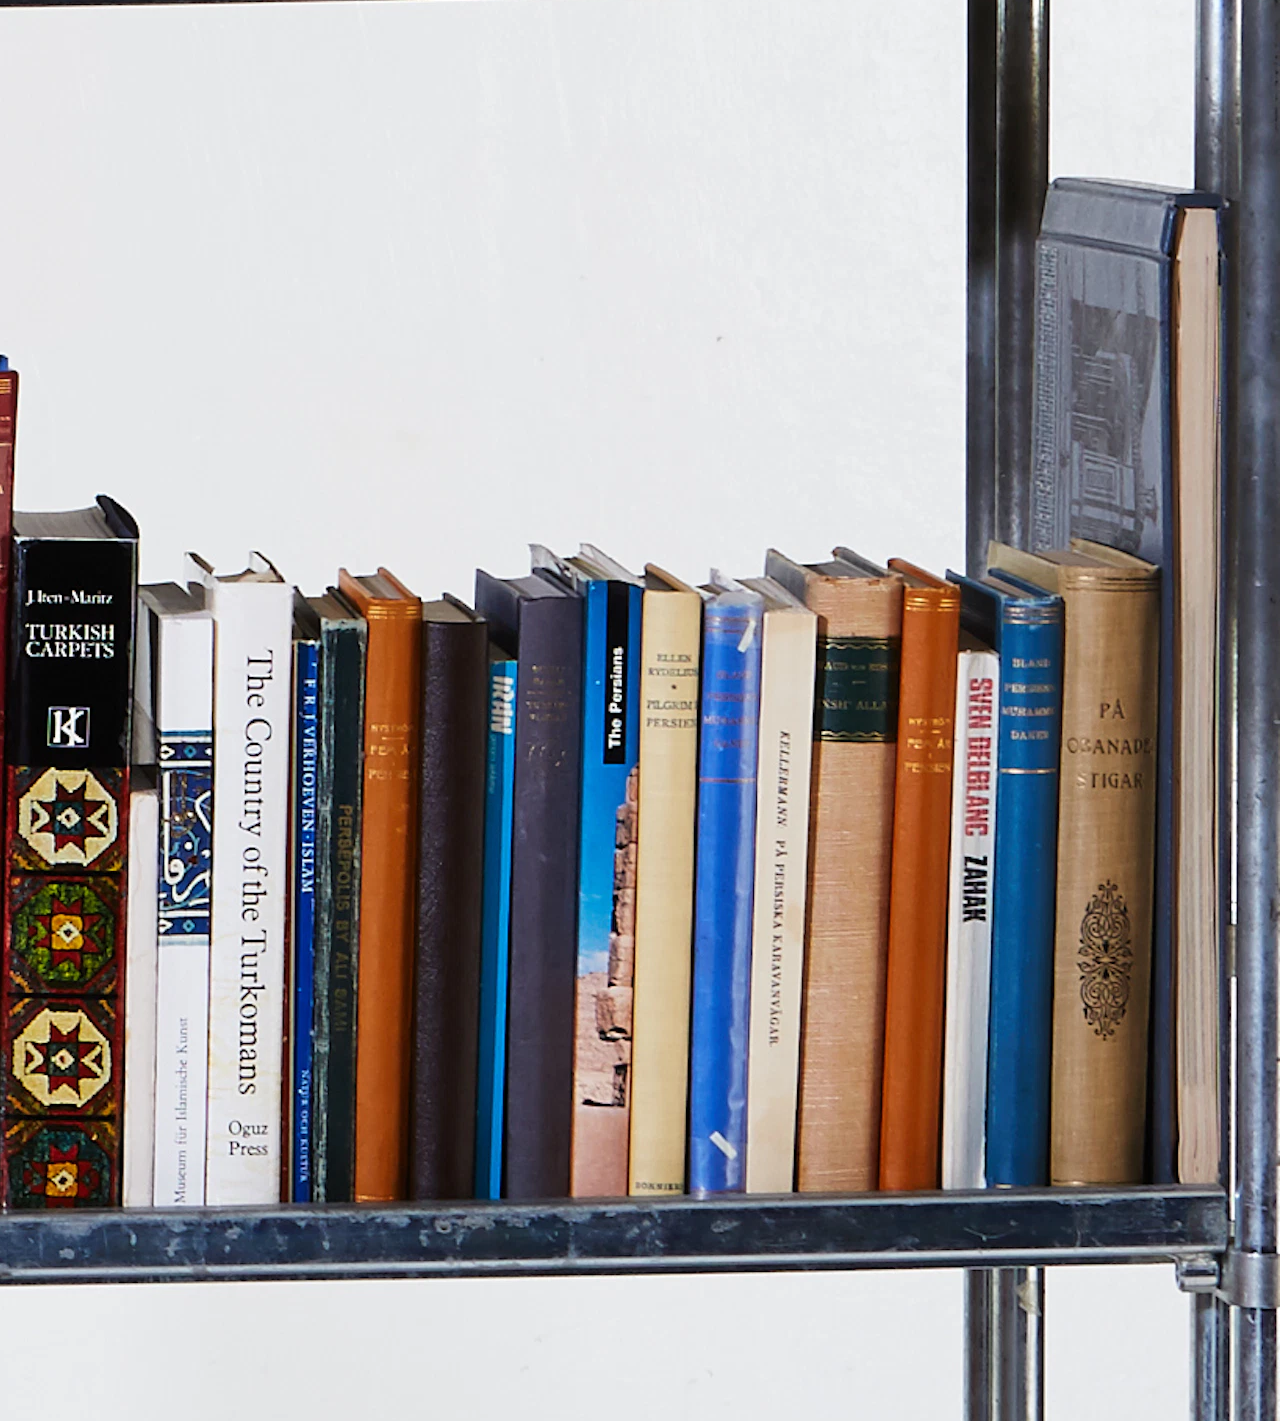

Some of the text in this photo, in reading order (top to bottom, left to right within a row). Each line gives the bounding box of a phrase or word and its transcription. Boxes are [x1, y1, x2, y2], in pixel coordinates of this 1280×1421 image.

[25, 622, 114, 642] TURKISH
[25, 641, 114, 660] CARPETS
[608, 647, 625, 750] The Persians
[775, 731, 791, 827] KELLERMANN
[961, 677, 994, 923] SVEN DELBLANC ZAHAK
[774, 839, 790, 858] PÅ
[236, 650, 275, 1096] The Country of the Turkomans
[771, 863, 788, 929] PERSISKA
[227, 1120, 269, 1138] Oguz
[227, 1140, 269, 1157] Press
